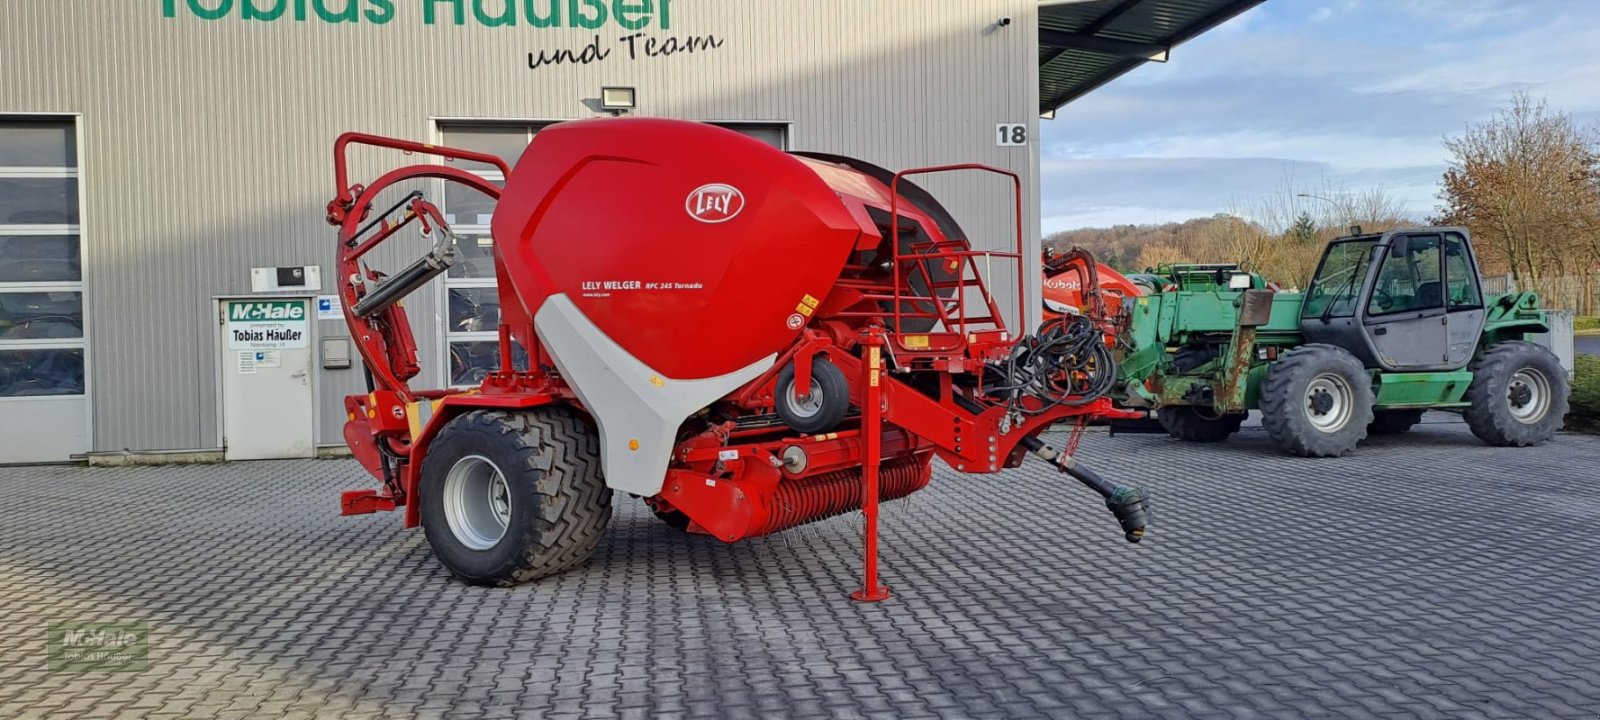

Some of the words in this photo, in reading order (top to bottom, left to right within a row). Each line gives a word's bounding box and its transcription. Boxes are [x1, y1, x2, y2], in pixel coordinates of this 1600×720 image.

[528, 35, 610, 69] und
[620, 33, 724, 60] Team
[999, 126, 1026, 144] 18
[696, 191, 733, 215] LELY
[582, 281, 601, 290] LELY
[604, 281, 641, 290] WELGER
[232, 303, 304, 320] McHale
[233, 329, 264, 341] Tobias
[266, 328, 302, 341] Häußer
